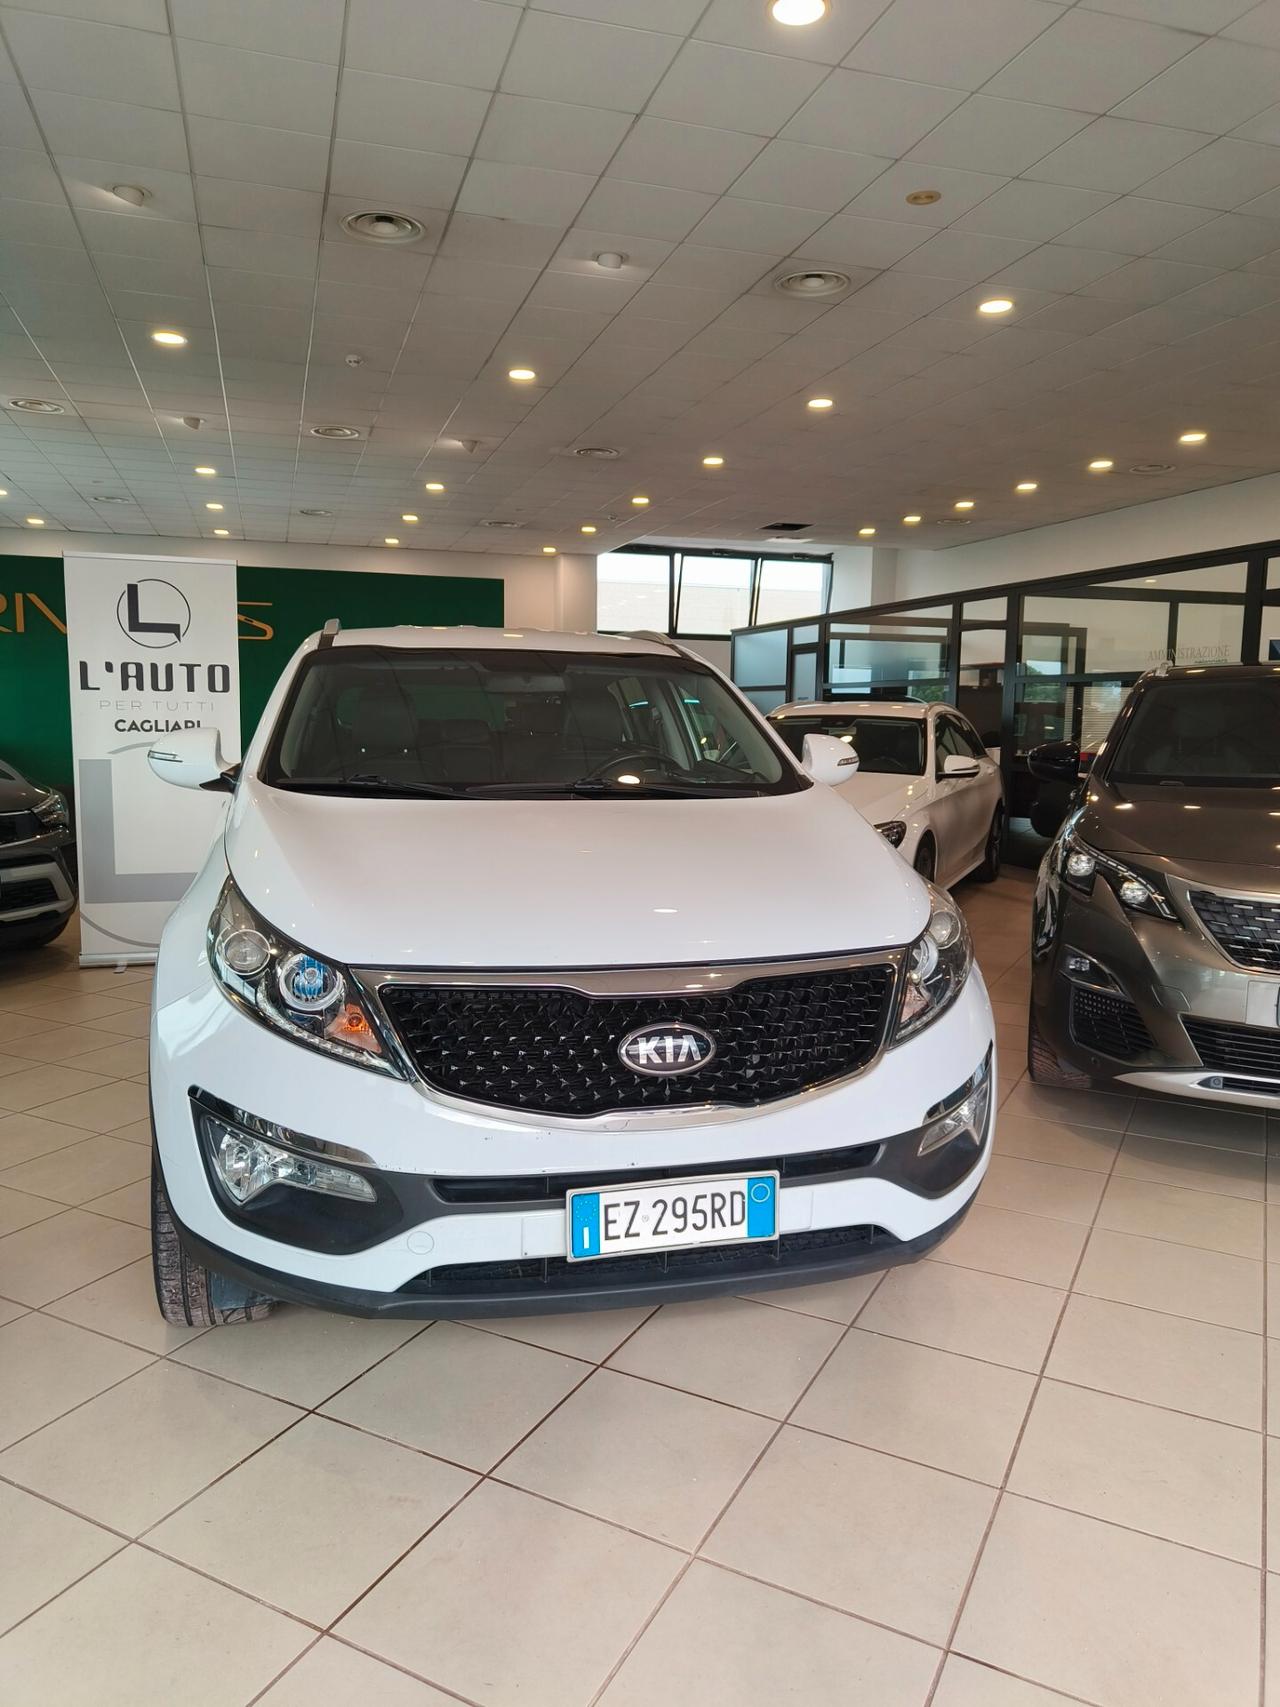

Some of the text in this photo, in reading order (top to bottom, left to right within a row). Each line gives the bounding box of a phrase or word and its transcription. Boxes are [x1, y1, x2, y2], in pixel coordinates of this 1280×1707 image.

[79, 660, 231, 693] L'AUTO
[99, 699, 215, 712] PER TUTTI
[637, 1035, 702, 1064] KIA
[603, 1200, 641, 1241] EZ
[651, 1190, 746, 1236] 295RD
